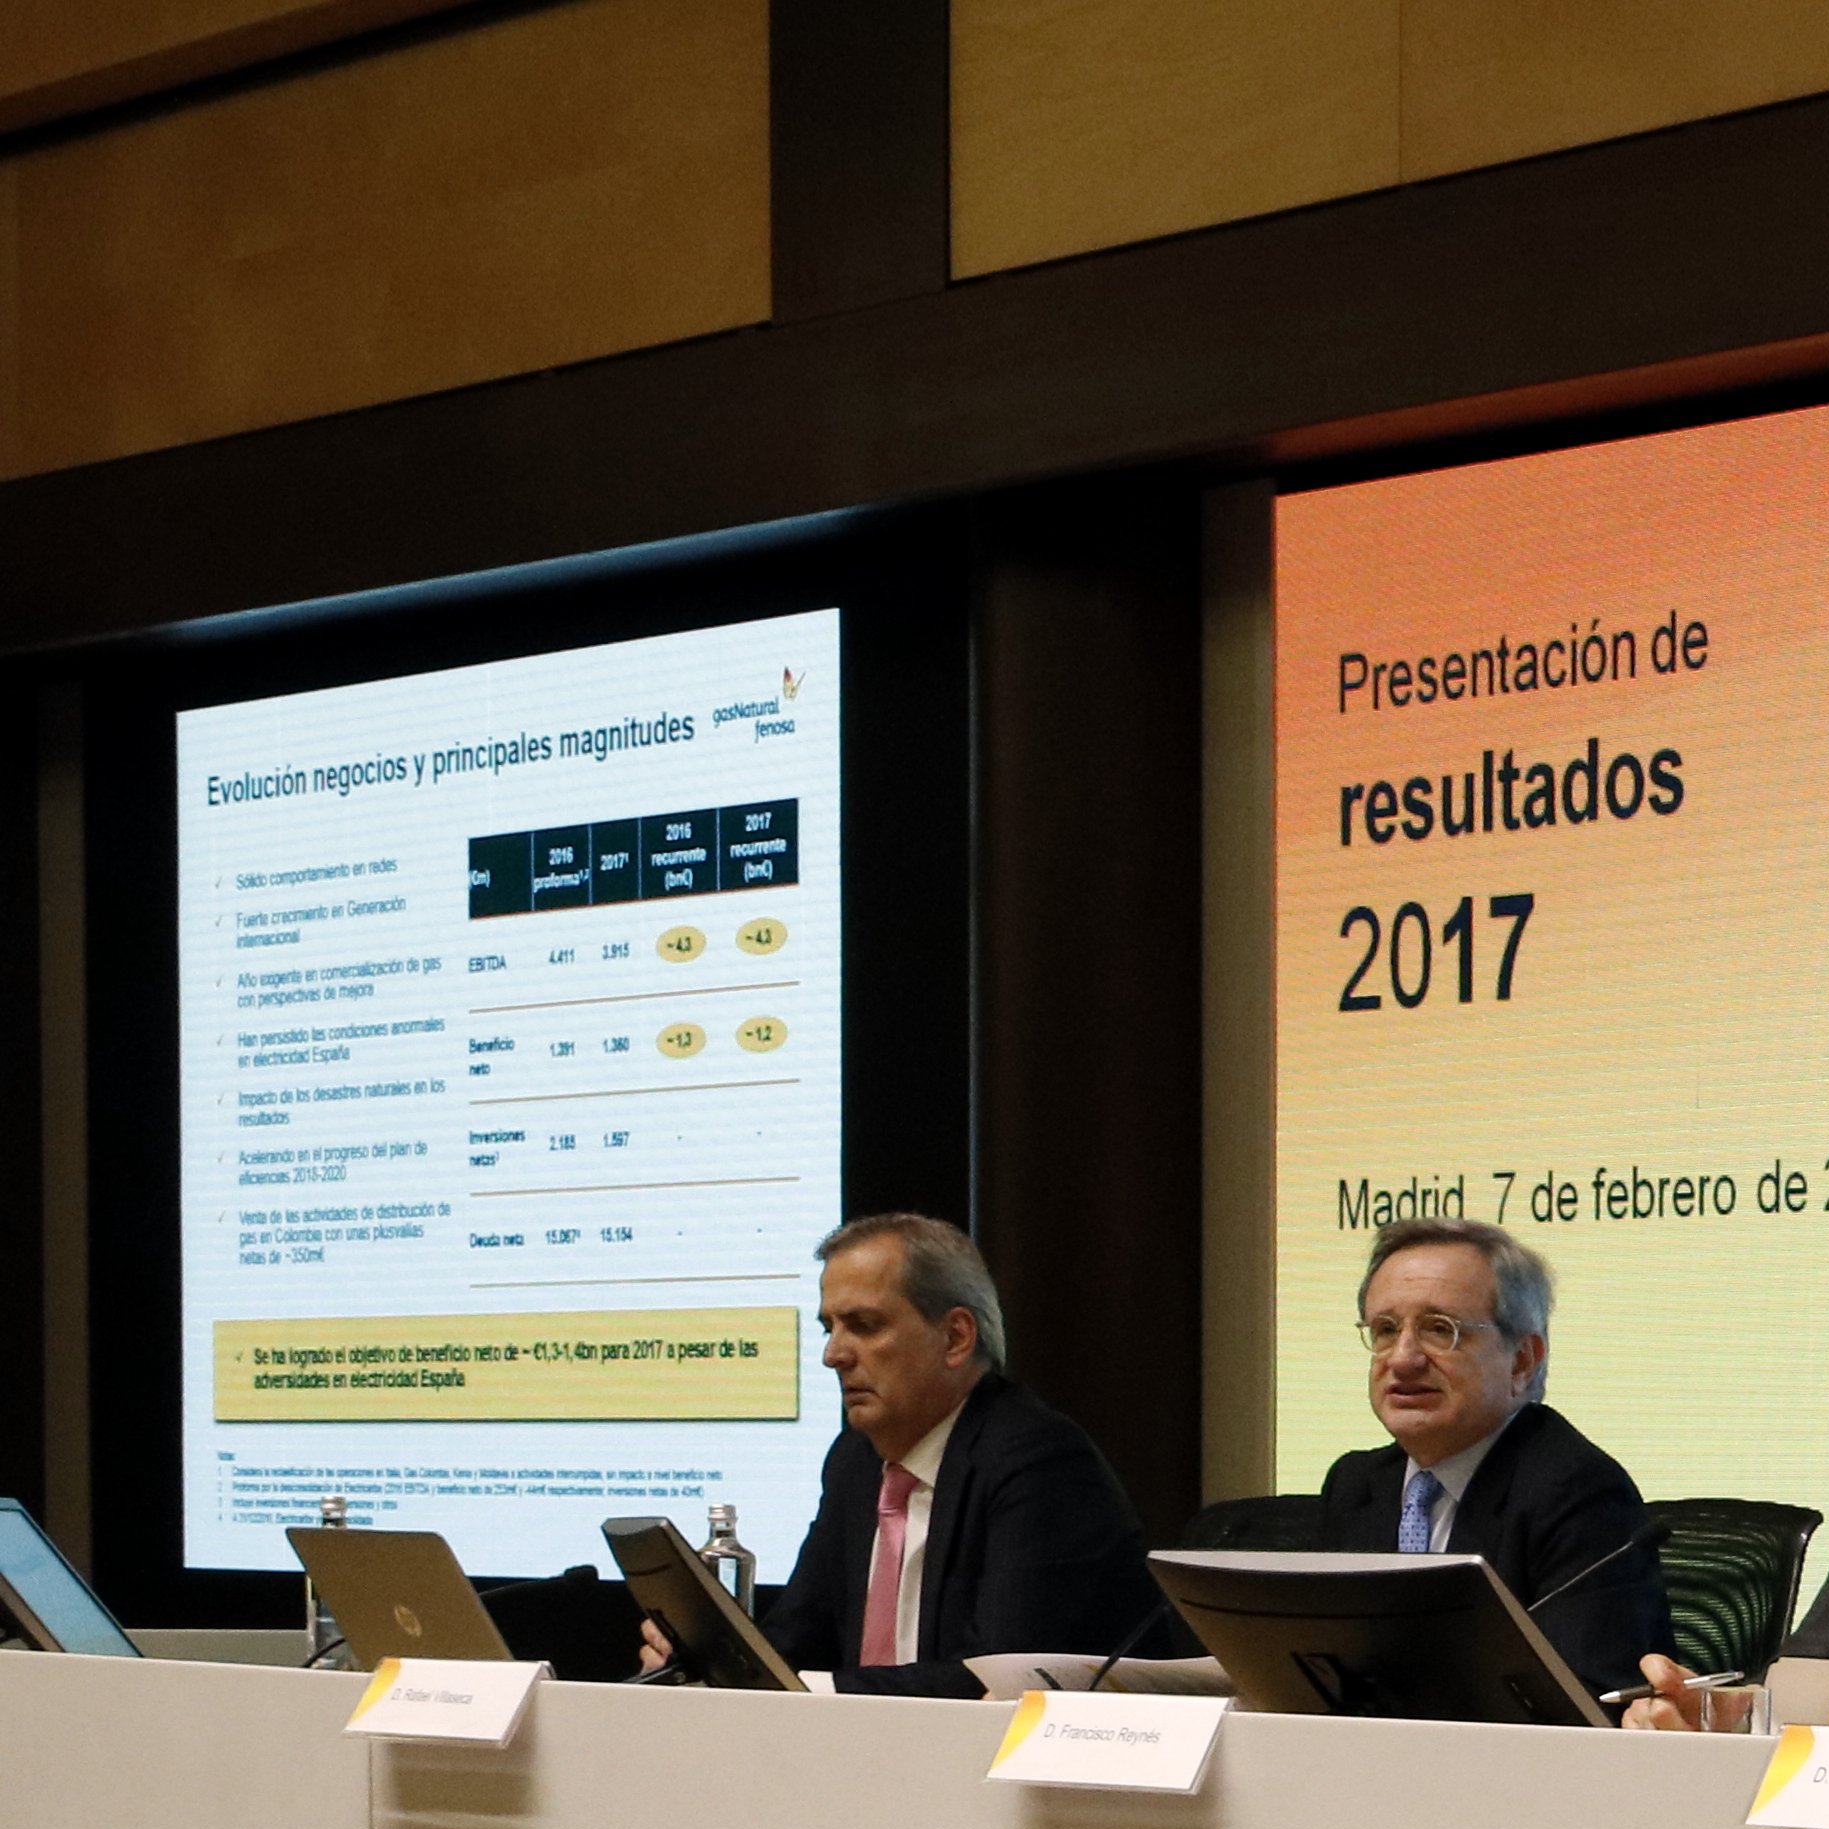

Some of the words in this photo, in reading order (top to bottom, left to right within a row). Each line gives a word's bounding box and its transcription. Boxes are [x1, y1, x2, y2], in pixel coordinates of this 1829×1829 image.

[1339, 617, 1637, 713] Presentación
[1650, 609, 1708, 674] de
[712, 697, 780, 728] gasNatural
[754, 719, 795, 743] fenosa
[207, 764, 307, 806] Evolución
[313, 753, 407, 796] negocios
[413, 754, 426, 787] y
[433, 732, 551, 784] principales
[559, 711, 695, 761] magnitudes
[1339, 736, 1687, 847] resultados
[745, 812, 772, 832] 2017
[1337, 892, 1536, 1012] 2017
[1492, 1171, 1516, 1225] 7
[1531, 1170, 1579, 1223] de
[1592, 1166, 1737, 1222] febrero
[1756, 1159, 1807, 1214] de
[601, 1342, 630, 1365] para
[632, 1339, 664, 1359] 2017
[666, 1342, 675, 1359] a
[678, 1341, 715, 1364] pesar
[718, 1338, 735, 1358] de
[738, 1338, 759, 1358] las
[1059, 1724, 1116, 1742] Francisco
[1117, 1726, 1162, 1746] Reynés
[1812, 1766, 1829, 1784] D.
